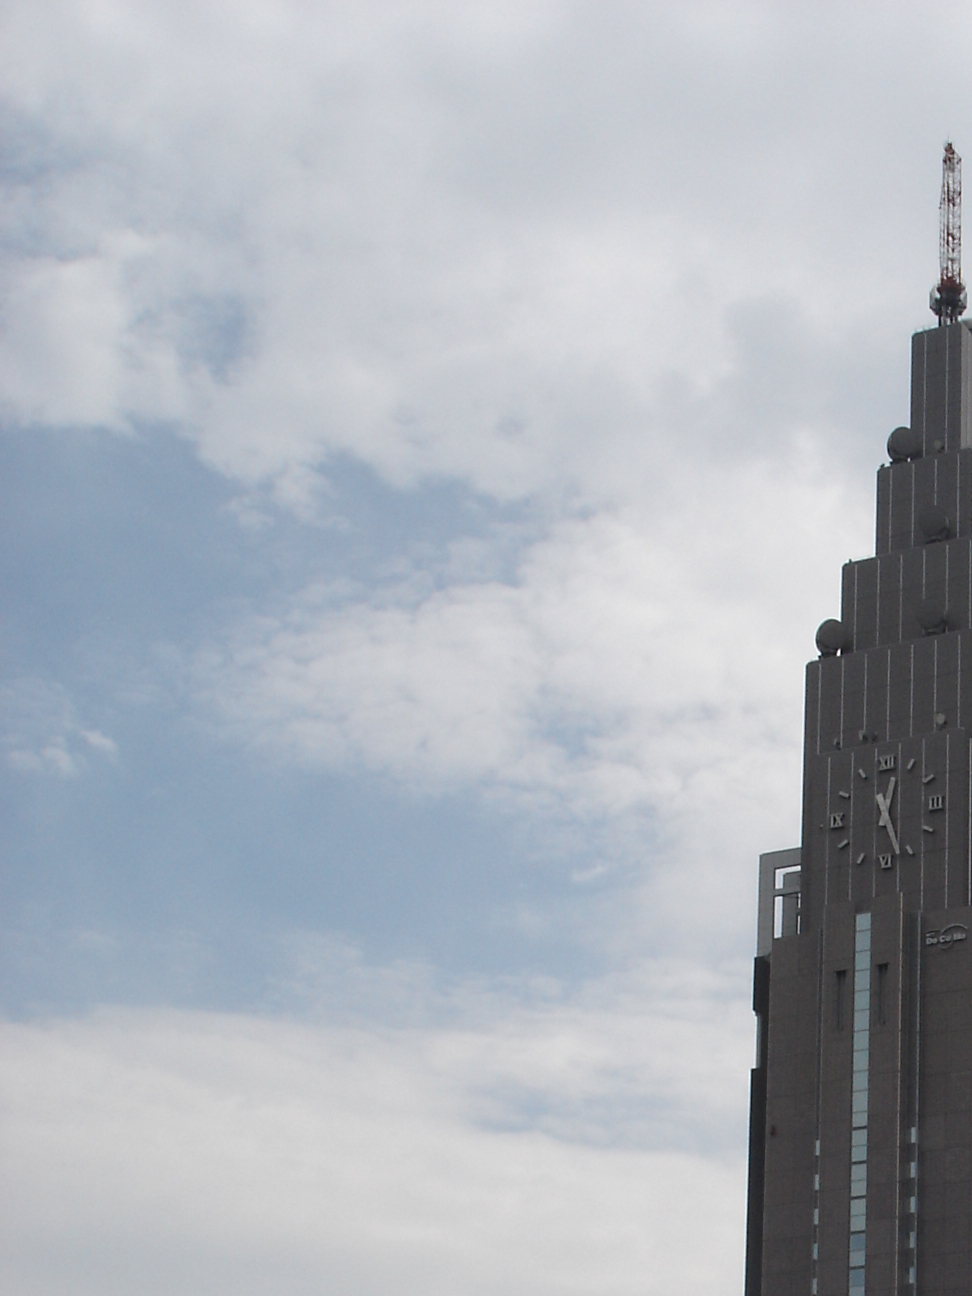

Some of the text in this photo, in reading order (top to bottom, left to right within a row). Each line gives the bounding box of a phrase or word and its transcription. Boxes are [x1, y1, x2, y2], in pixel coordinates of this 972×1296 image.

[878, 755, 895, 772] XII
[928, 795, 943, 811] III
[829, 813, 845, 829] IX
[878, 853, 893, 869] VI
